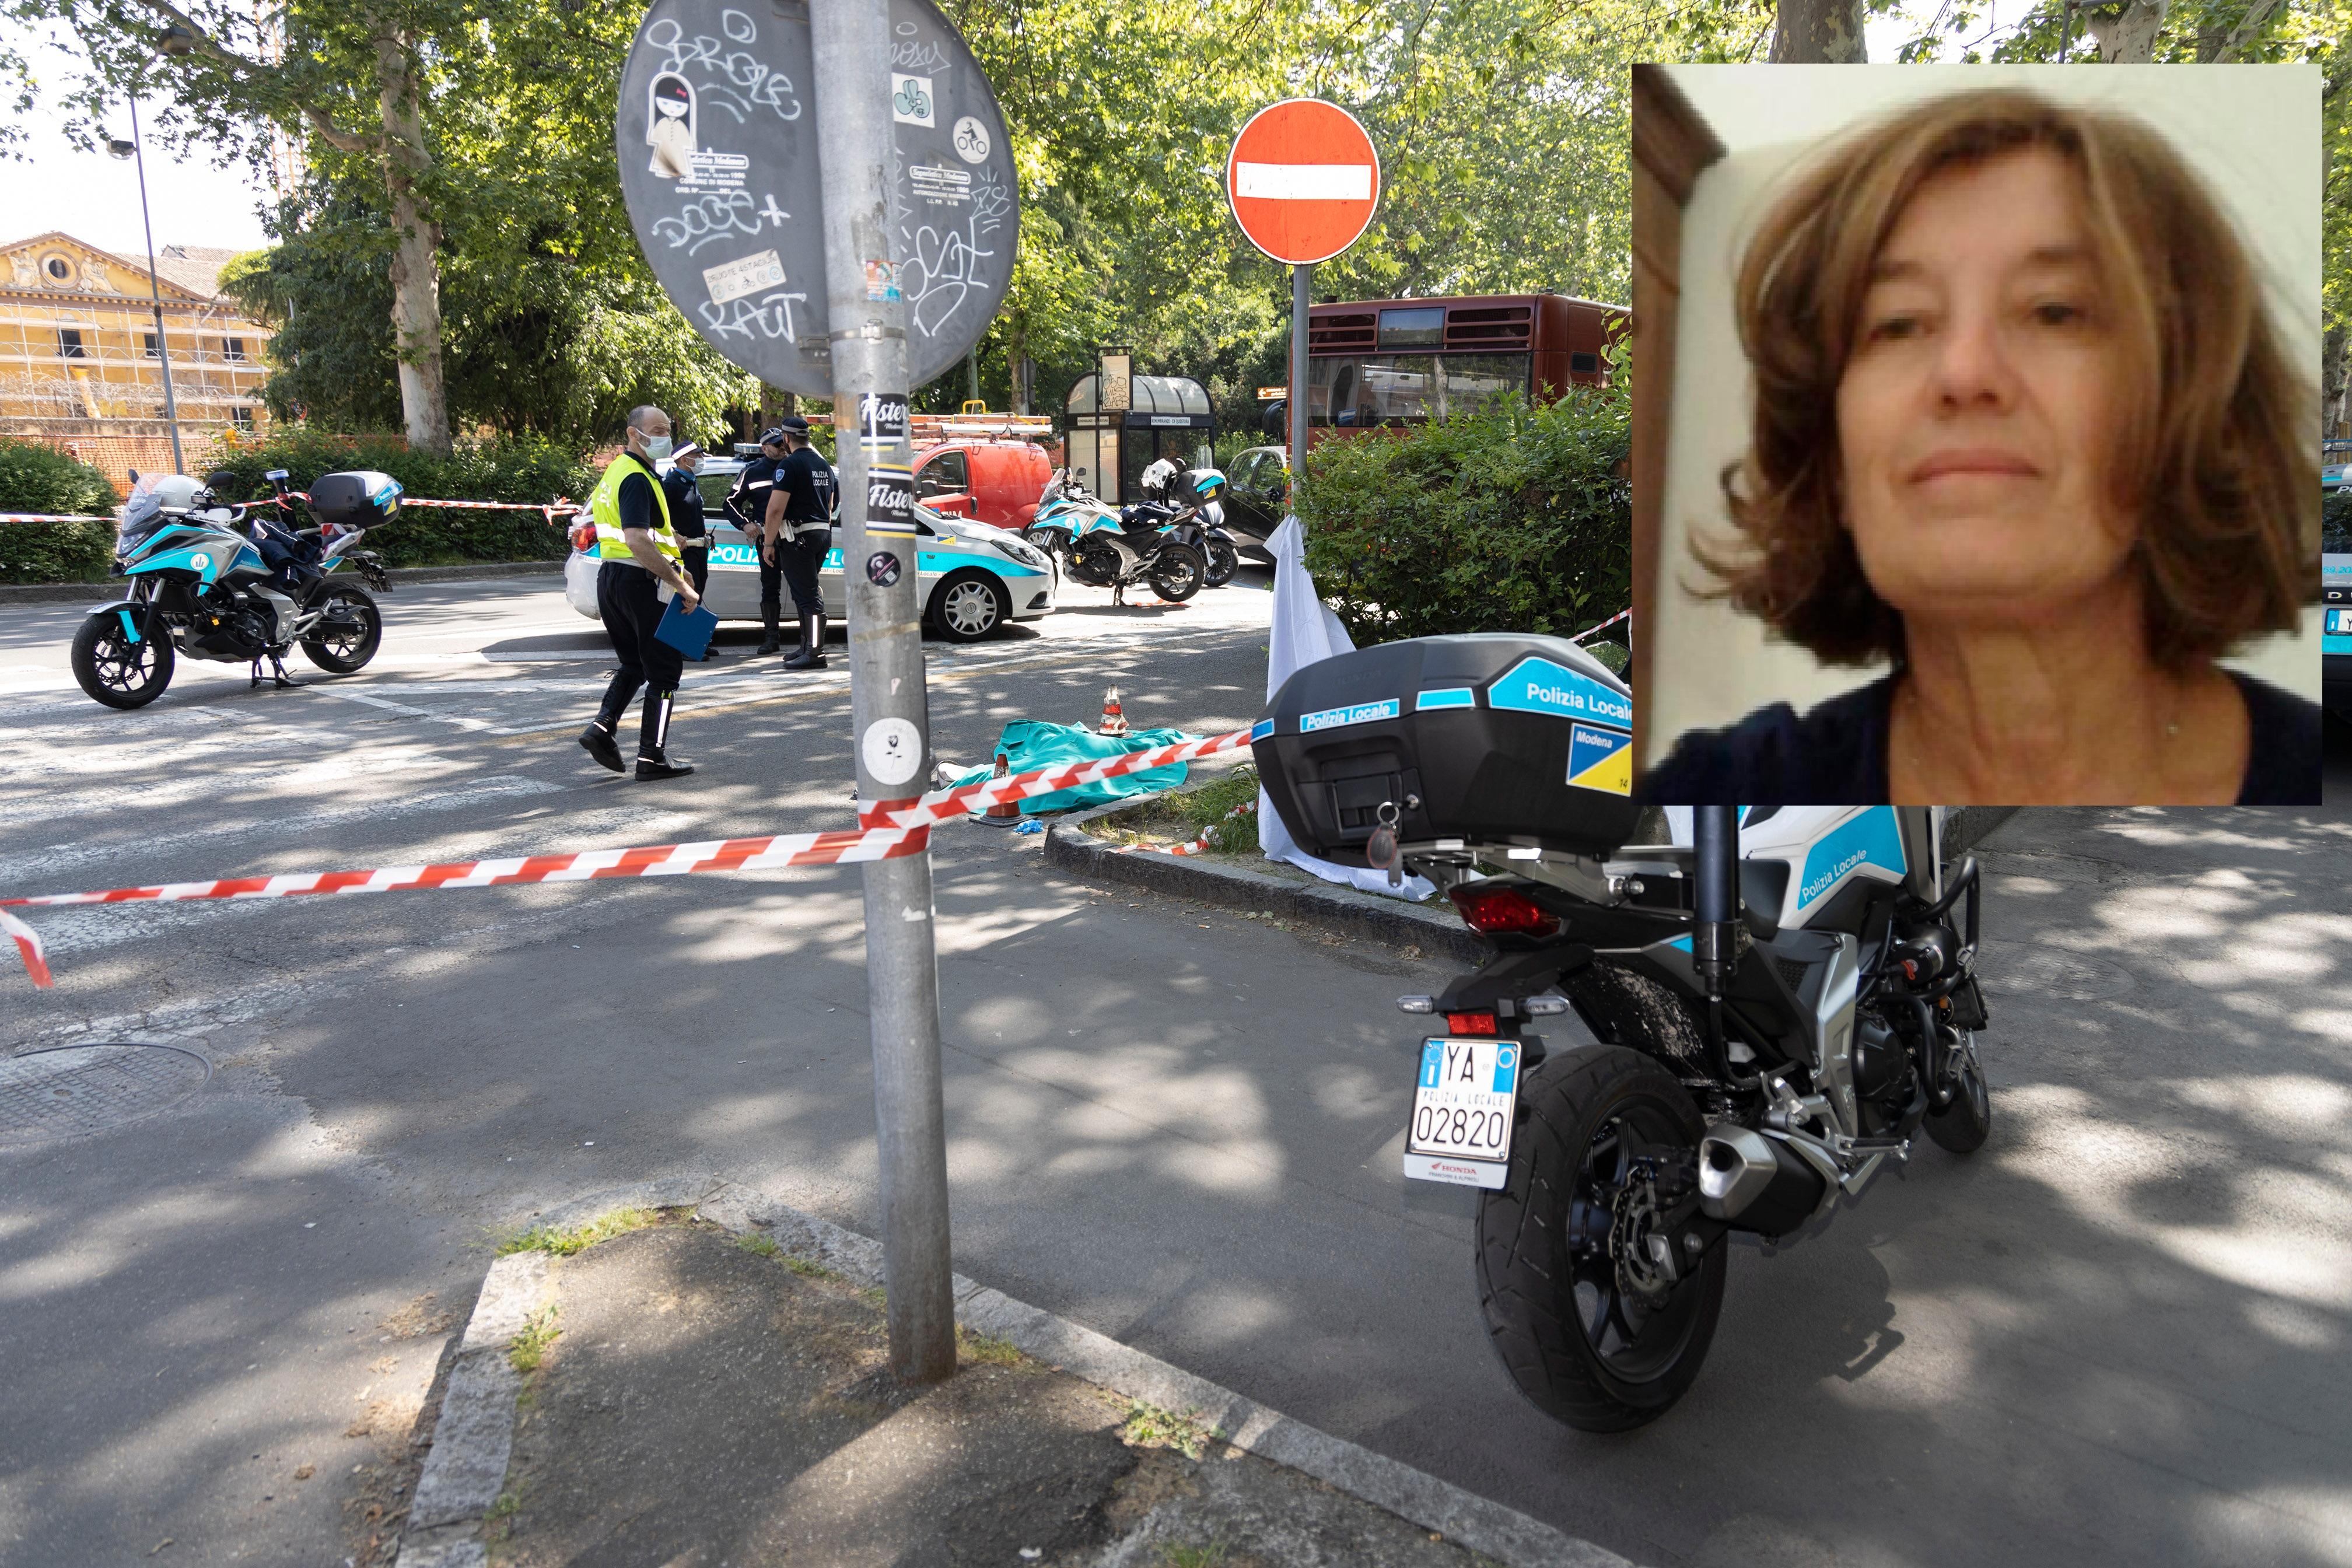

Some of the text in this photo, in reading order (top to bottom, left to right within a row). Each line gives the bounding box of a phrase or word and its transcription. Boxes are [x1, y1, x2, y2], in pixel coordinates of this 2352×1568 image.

[708, 547, 760, 564] POLIZ
[1527, 682, 1632, 720] Polizia Local
[1306, 704, 1391, 730] Polizia Locale
[1576, 731, 1613, 748] Modena
[1619, 778, 1628, 789] 14
[1802, 849, 1867, 901] Polizia Locale
[1447, 1046, 1474, 1083] YA
[1424, 1091, 1504, 1107] POLIZIA LOCALE
[1416, 1106, 1504, 1149] 02820
[1442, 1165, 1477, 1175] HONDA
